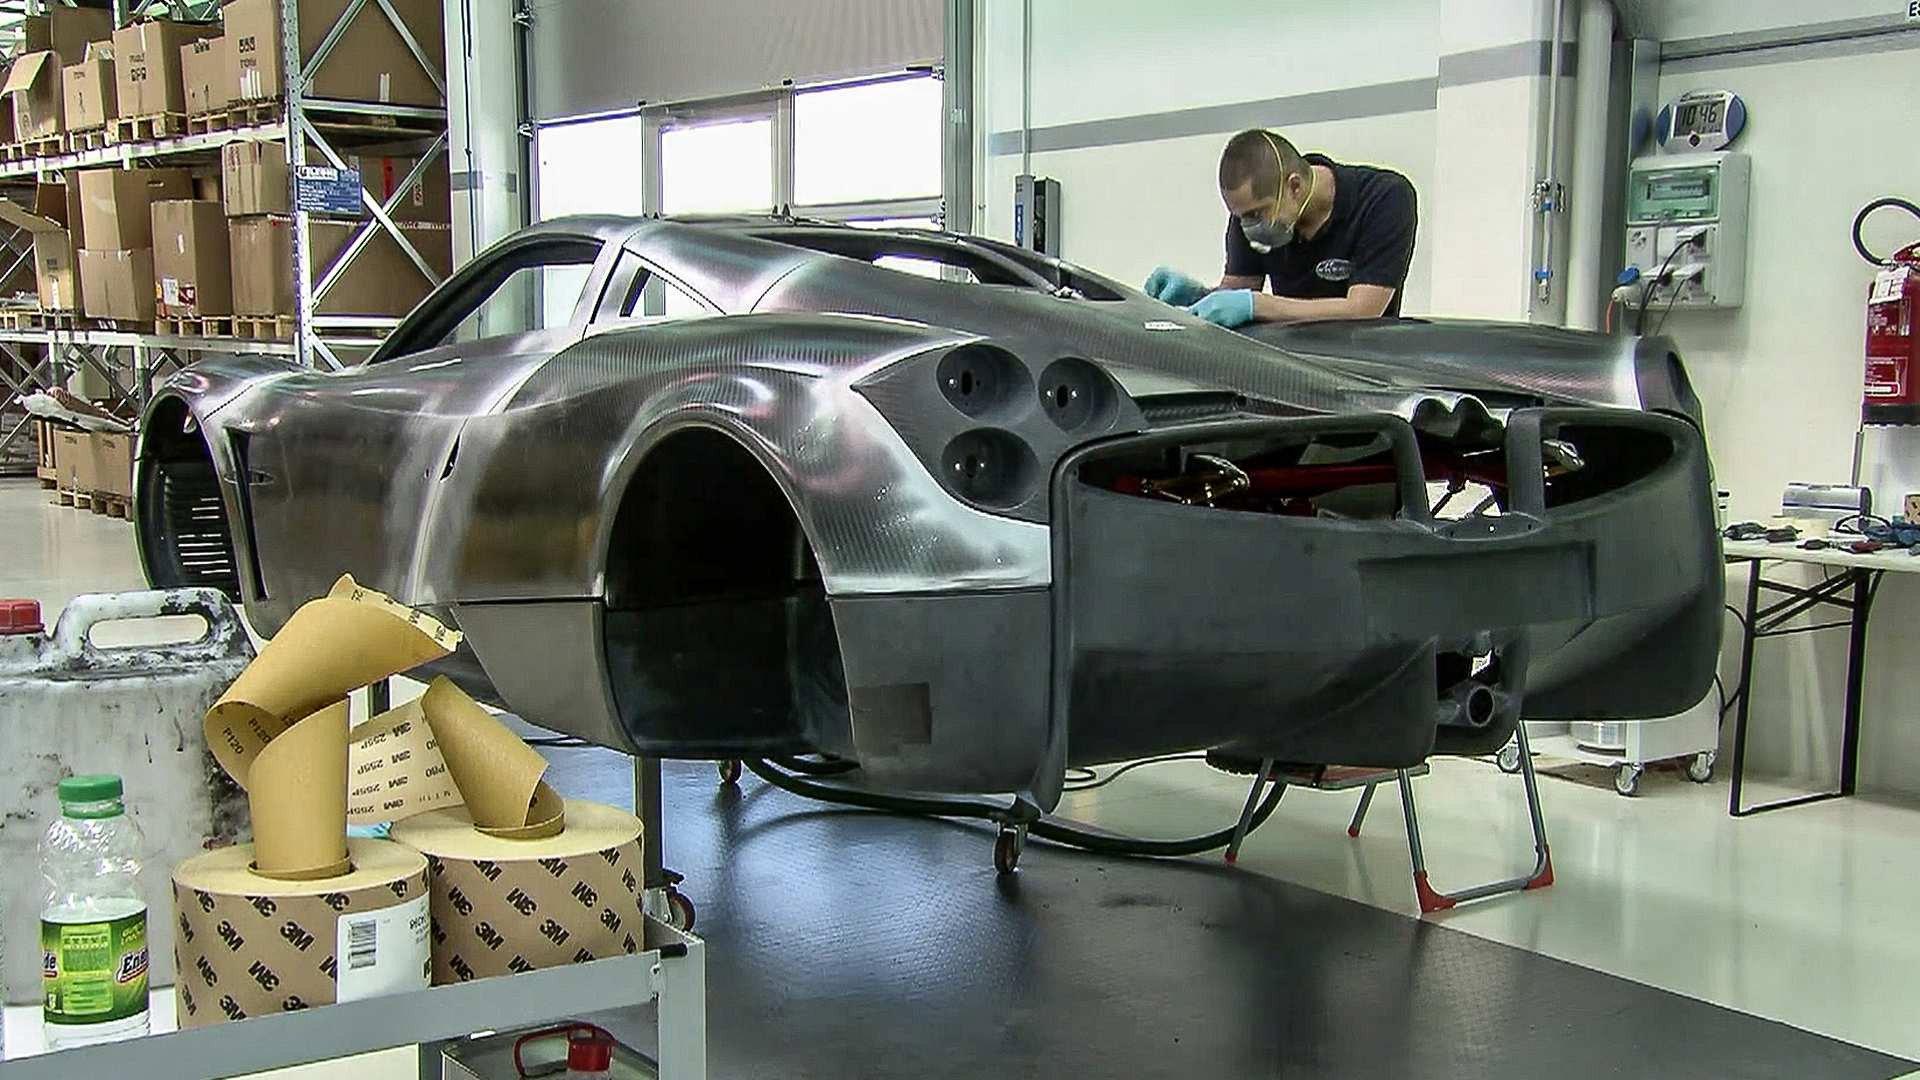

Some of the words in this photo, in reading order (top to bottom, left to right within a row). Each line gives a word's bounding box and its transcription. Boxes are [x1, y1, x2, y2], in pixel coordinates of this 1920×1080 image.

[449, 887, 474, 916] 3M
[507, 888, 538, 916] 3M
[571, 881, 598, 908] 3M
[540, 919, 570, 946] 3M
[600, 908, 622, 934] 3M
[217, 921, 244, 952] 3M
[280, 921, 315, 952] 3M
[475, 922, 504, 950] 3M
[197, 956, 218, 987] 3M
[249, 961, 280, 992] 3M
